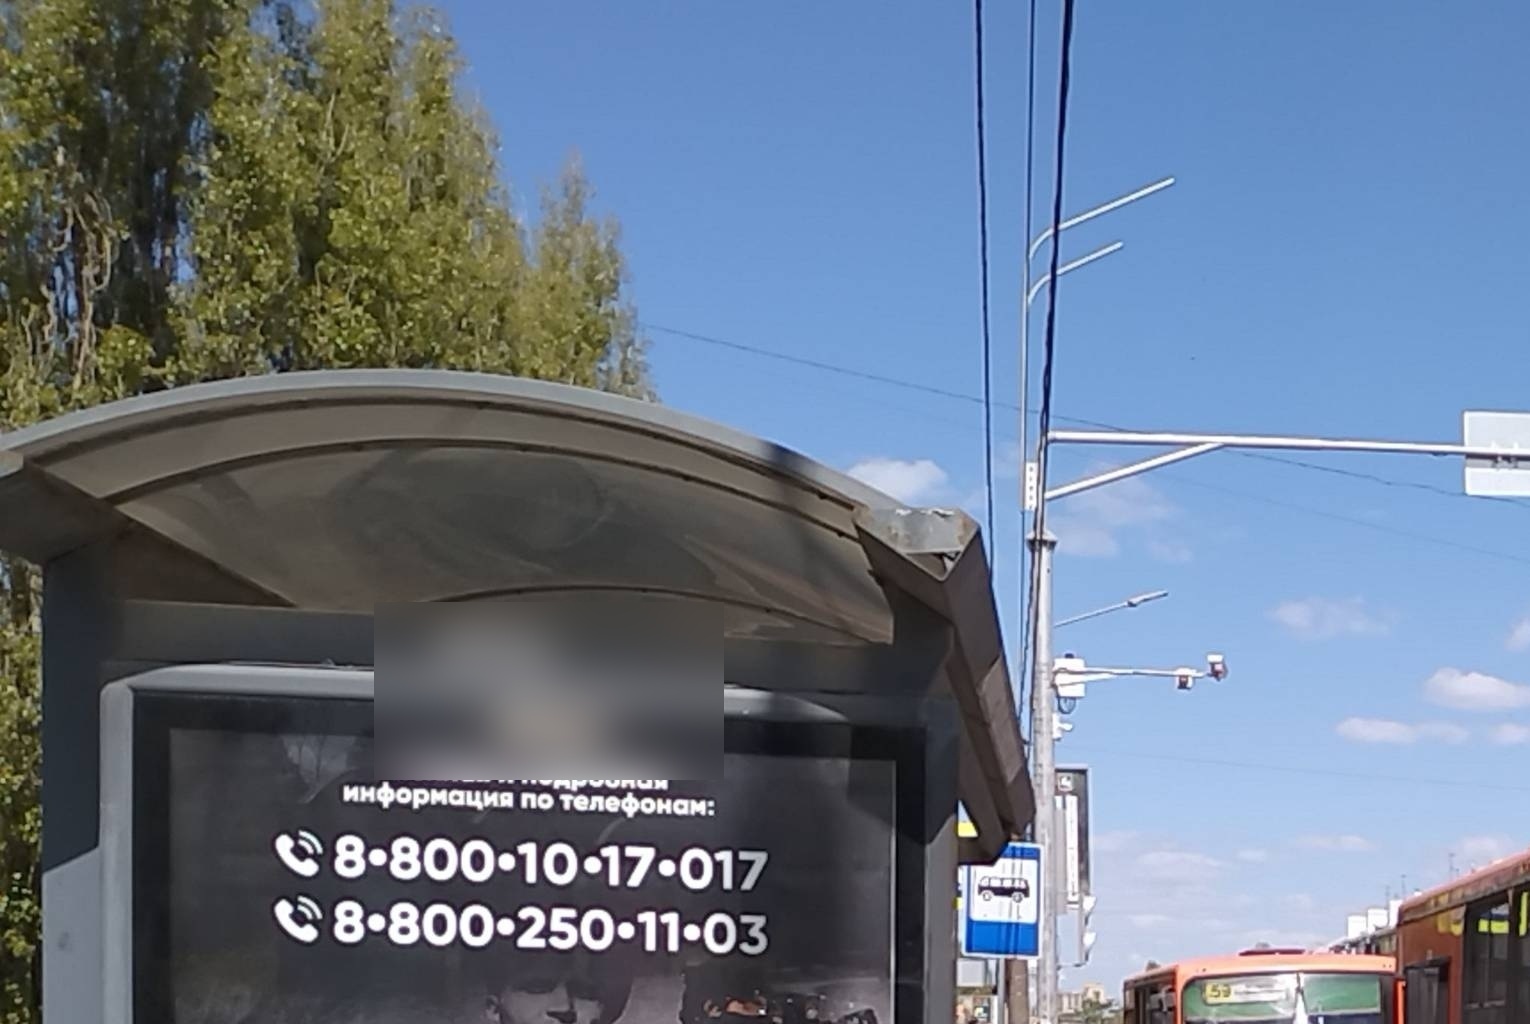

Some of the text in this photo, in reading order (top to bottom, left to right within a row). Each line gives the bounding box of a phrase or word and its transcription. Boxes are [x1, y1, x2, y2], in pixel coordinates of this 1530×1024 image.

[342, 780, 716, 819] информация по телефонам:
